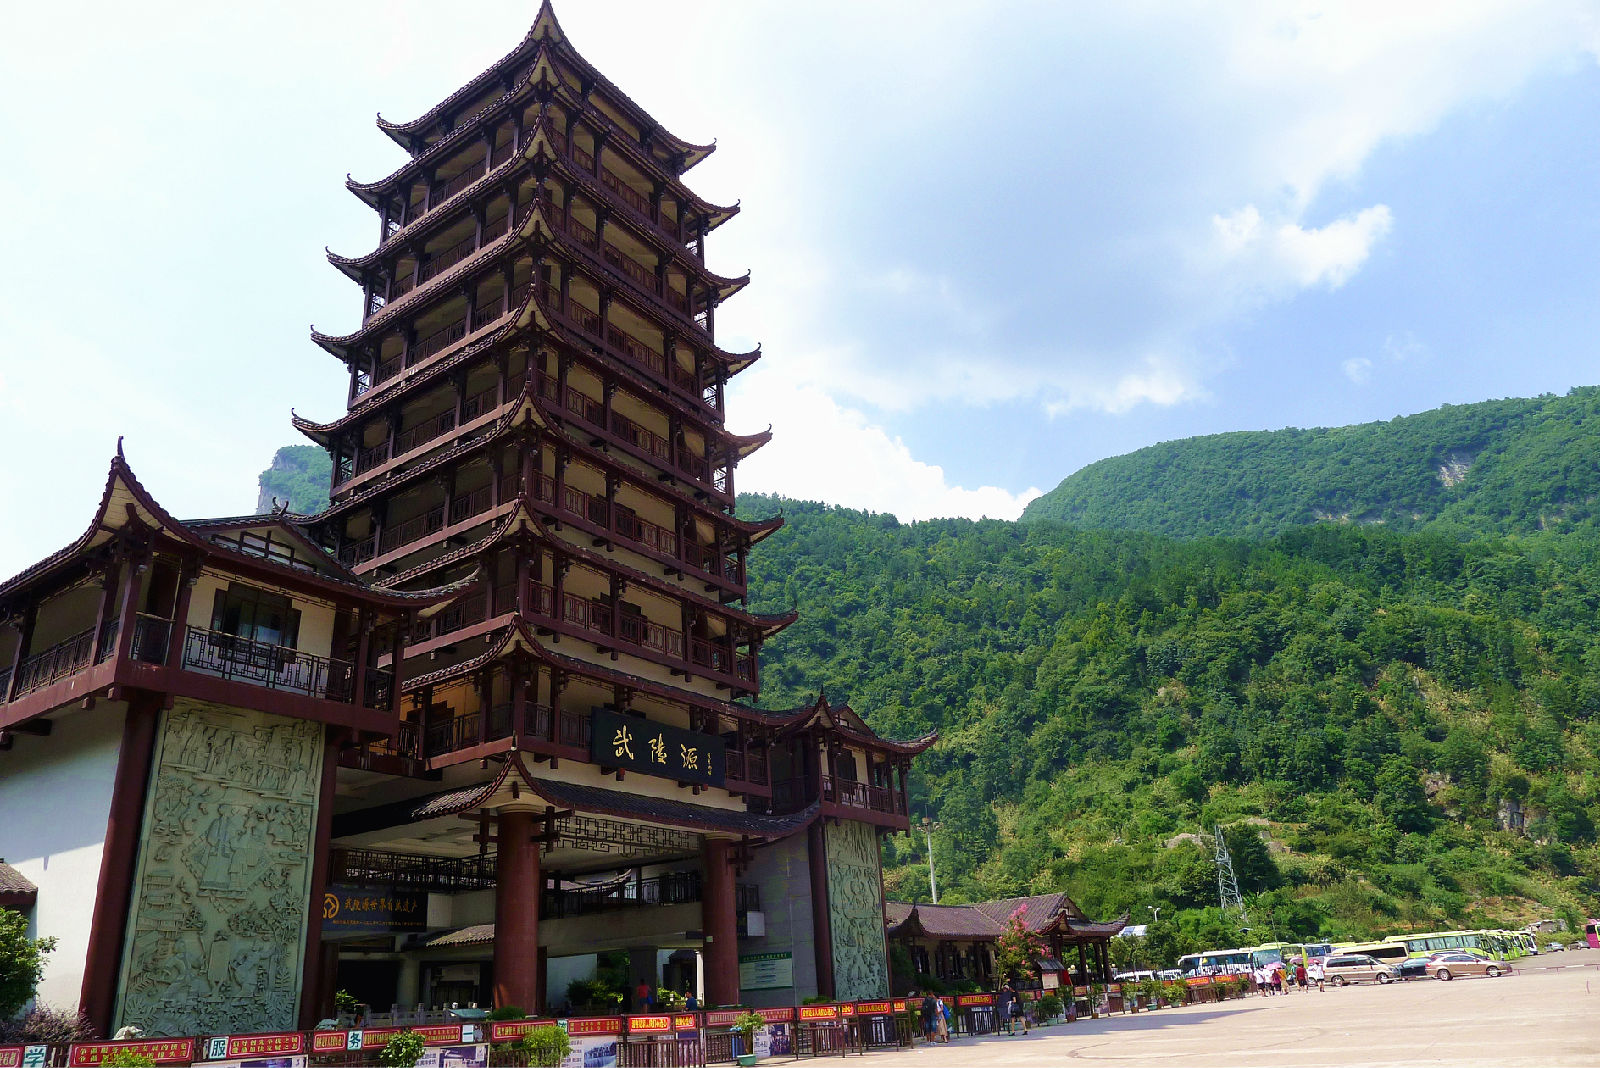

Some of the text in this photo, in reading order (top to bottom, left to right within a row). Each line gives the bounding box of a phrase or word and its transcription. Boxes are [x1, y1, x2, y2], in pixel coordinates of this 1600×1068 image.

[613, 724, 698, 770] 武陵源
[211, 1040, 226, 1057] 服
[349, 1033, 361, 1048] 务
